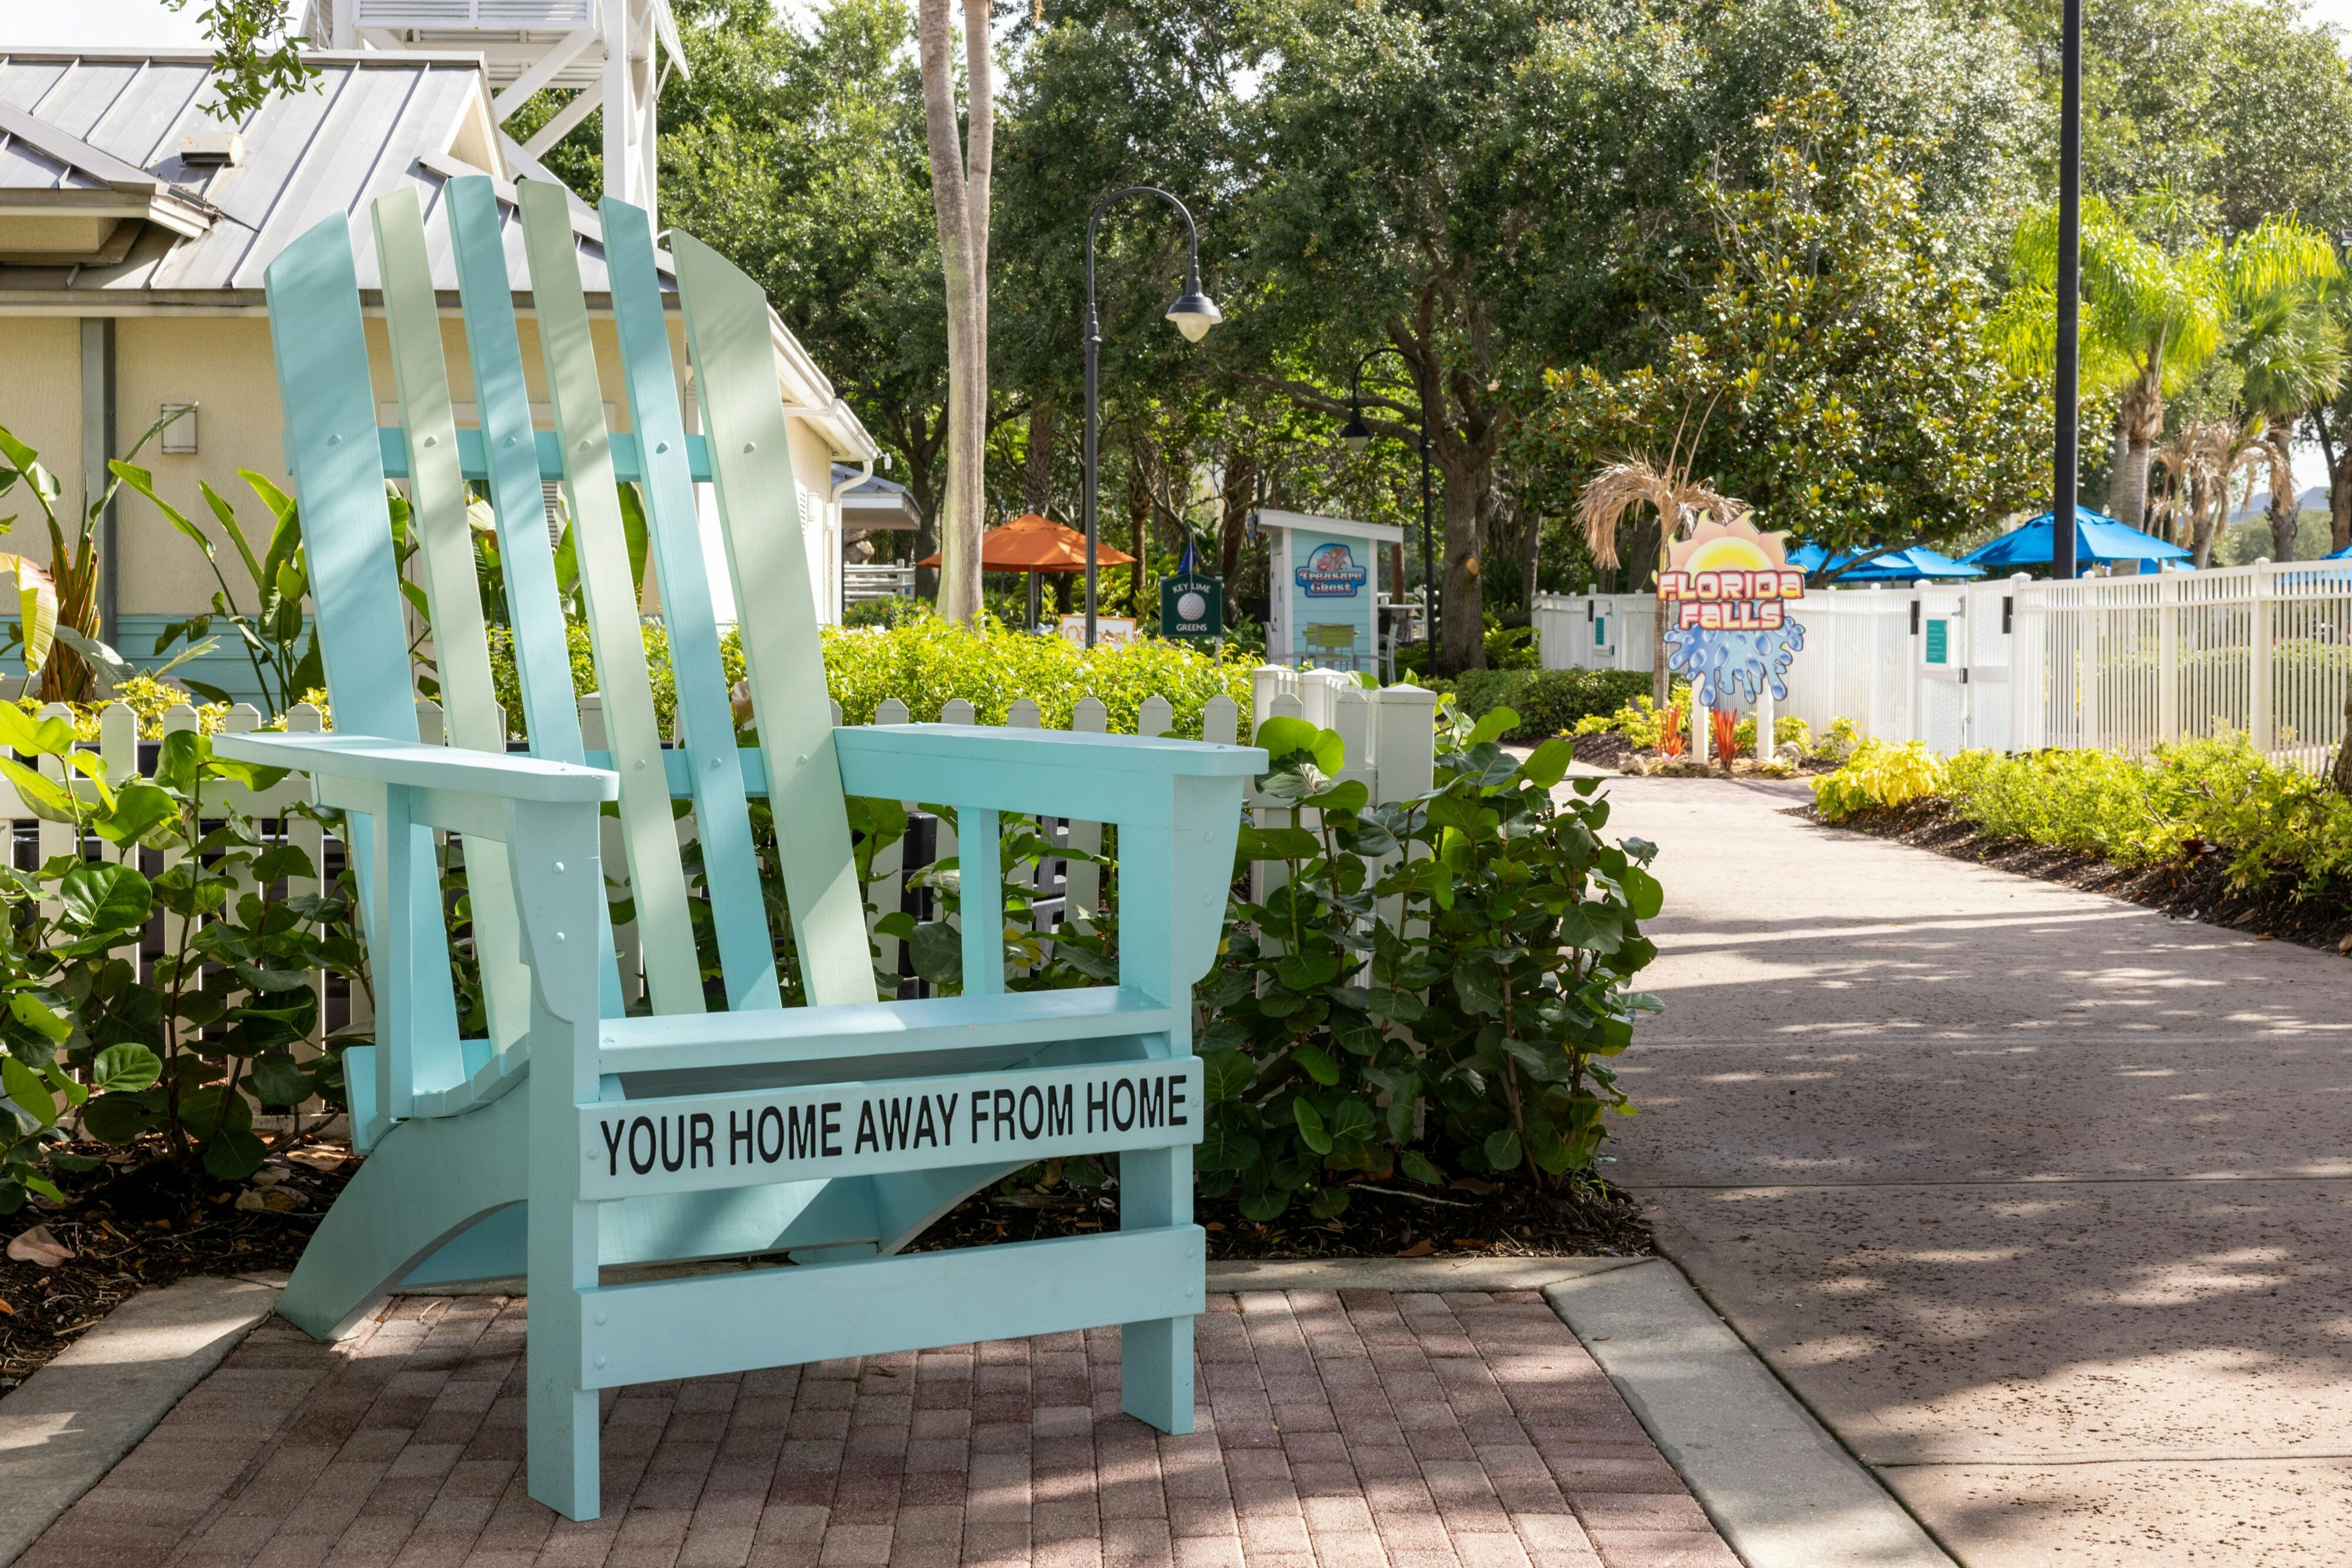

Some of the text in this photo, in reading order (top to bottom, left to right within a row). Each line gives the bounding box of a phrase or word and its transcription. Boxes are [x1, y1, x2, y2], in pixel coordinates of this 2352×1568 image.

[1299, 570, 1362, 581] Treasure
[1172, 582, 1211, 594] KEY LIME
[1310, 581, 1352, 593] Chest
[600, 1074, 1188, 1176] YOUR HOME AWAY FROM HOME
